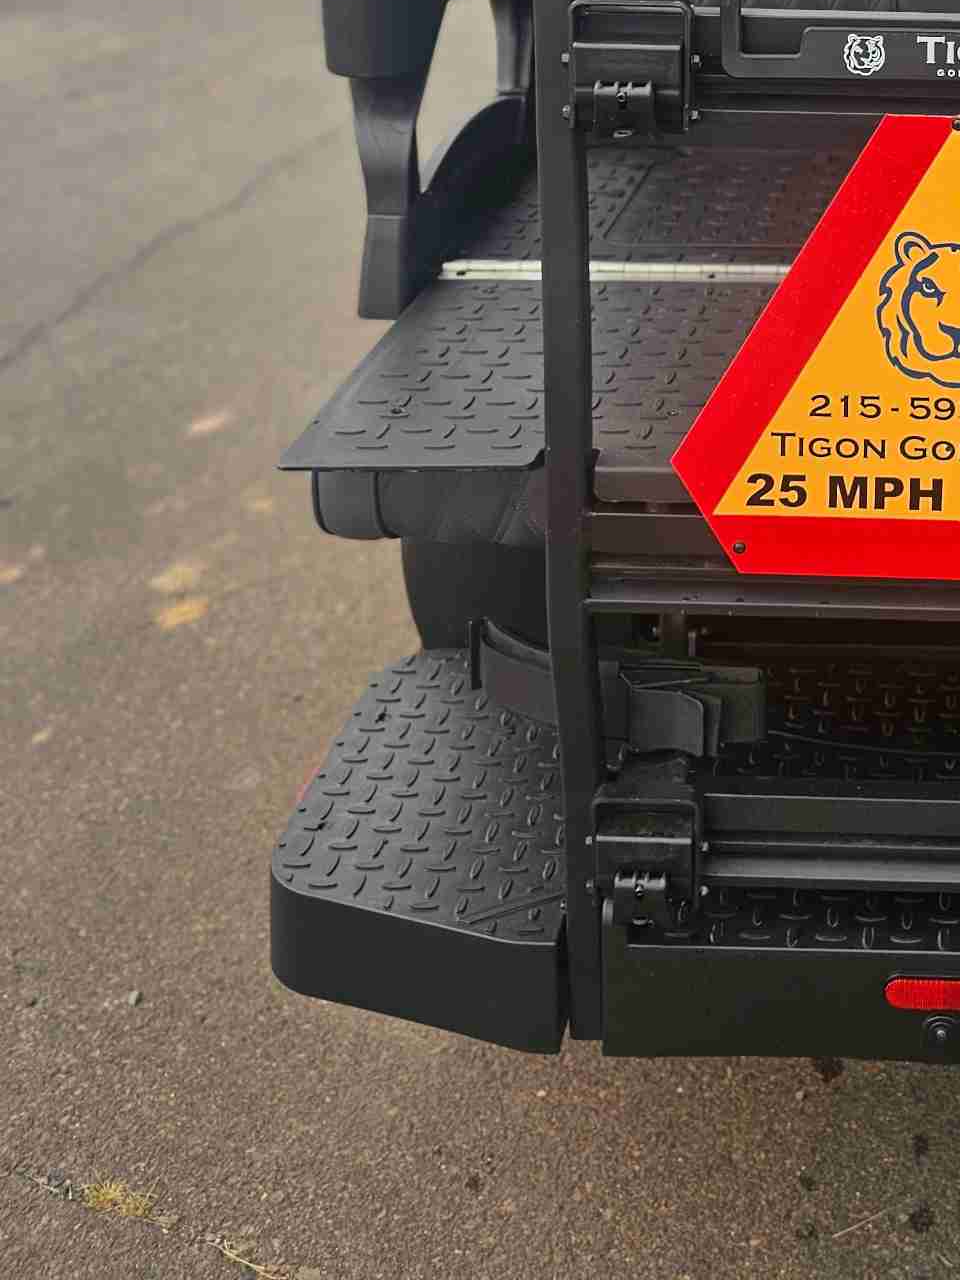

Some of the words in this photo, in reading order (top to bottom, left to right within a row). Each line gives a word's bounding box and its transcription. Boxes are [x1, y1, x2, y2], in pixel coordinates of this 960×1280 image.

[770, 431, 888, 460] TIGON
[744, 472, 808, 509] 25
[827, 474, 945, 512] MPH
